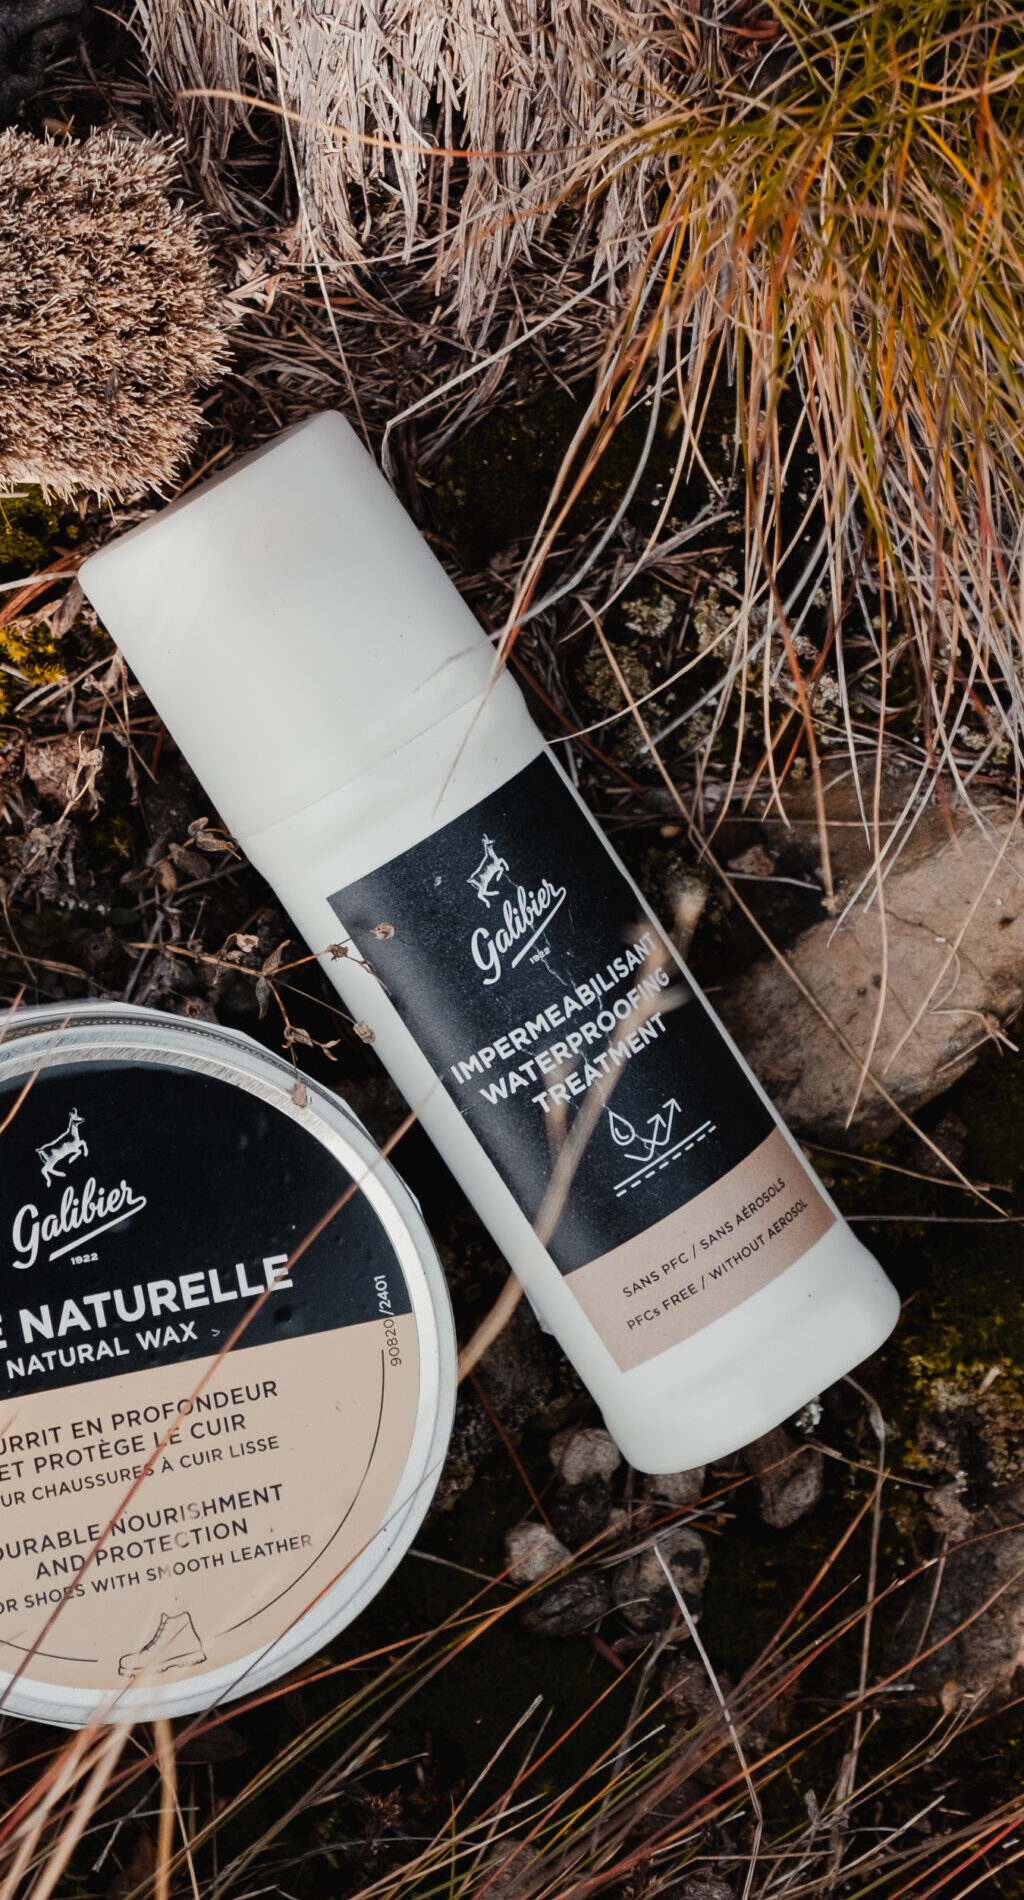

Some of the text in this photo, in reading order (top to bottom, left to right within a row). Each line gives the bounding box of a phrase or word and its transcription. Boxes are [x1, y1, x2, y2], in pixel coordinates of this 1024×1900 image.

[471, 879, 566, 985] Galibier
[529, 946, 551, 965] 1922
[450, 931, 657, 1084] IMPERMEABILISANT
[479, 967, 670, 1105] WATERPROOFING
[531, 1012, 667, 1114] TREATMENT
[12, 1176, 147, 1269] Galibier
[71, 1252, 99, 1265] 1922
[623, 1270, 660, 1298] SANS
[661, 1252, 689, 1275] PFC
[700, 1221, 734, 1250] SANS
[735, 1177, 786, 1226] AÉROSOLS
[627, 1306, 661, 1330] PFCs
[662, 1283, 698, 1310] FREE
[708, 1234, 766, 1281] WITHOUT
[767, 1198, 808, 1240] AEROSOL
[20, 1253, 294, 1343] NATURELLE
[374, 1275, 402, 1367] 90820/2401
[5, 1321, 198, 1379] NATURAL WAX
[34, 1432, 146, 1475] PROTÈGE
[156, 1428, 182, 1449] LE
[190, 1413, 247, 1440] CUIR
[71, 1417, 103, 1440] EN
[111, 1380, 278, 1432] PROFONDEUR
[32, 1463, 154, 1502] CHAUSSURES
[161, 1454, 175, 1473] À
[180, 1447, 224, 1469] CUIR
[230, 1435, 280, 1458] LISSE
[110, 1483, 283, 1537] NOURISHMENT
[24, 1584, 86, 1610] SHOES
[90, 1573, 141, 1596] WITH
[146, 1556, 226, 1582] SMOOTH
[230, 1534, 312, 1565] LEATHER
[35, 1518, 248, 1580] AND PROTECTION
